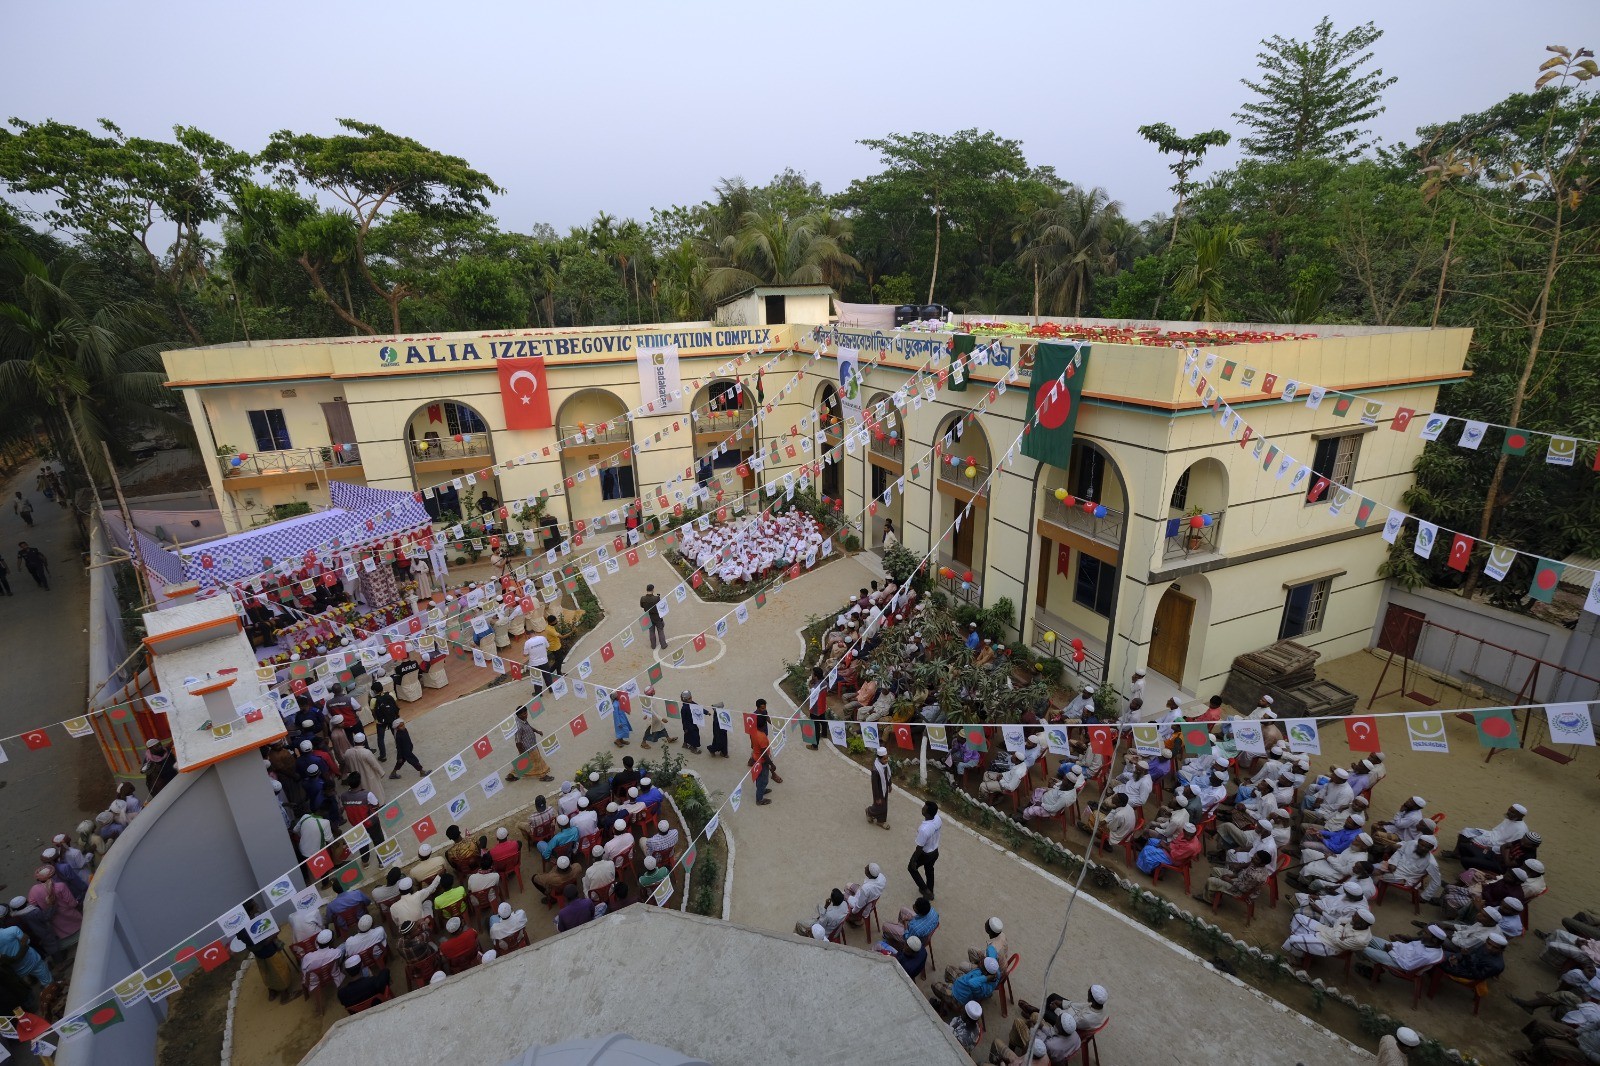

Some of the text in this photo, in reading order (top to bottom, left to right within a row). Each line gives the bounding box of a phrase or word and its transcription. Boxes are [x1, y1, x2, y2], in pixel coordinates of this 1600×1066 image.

[405, 328, 771, 364] ALIA IZZETBEGOVIC EDUCATION COMPLEX
